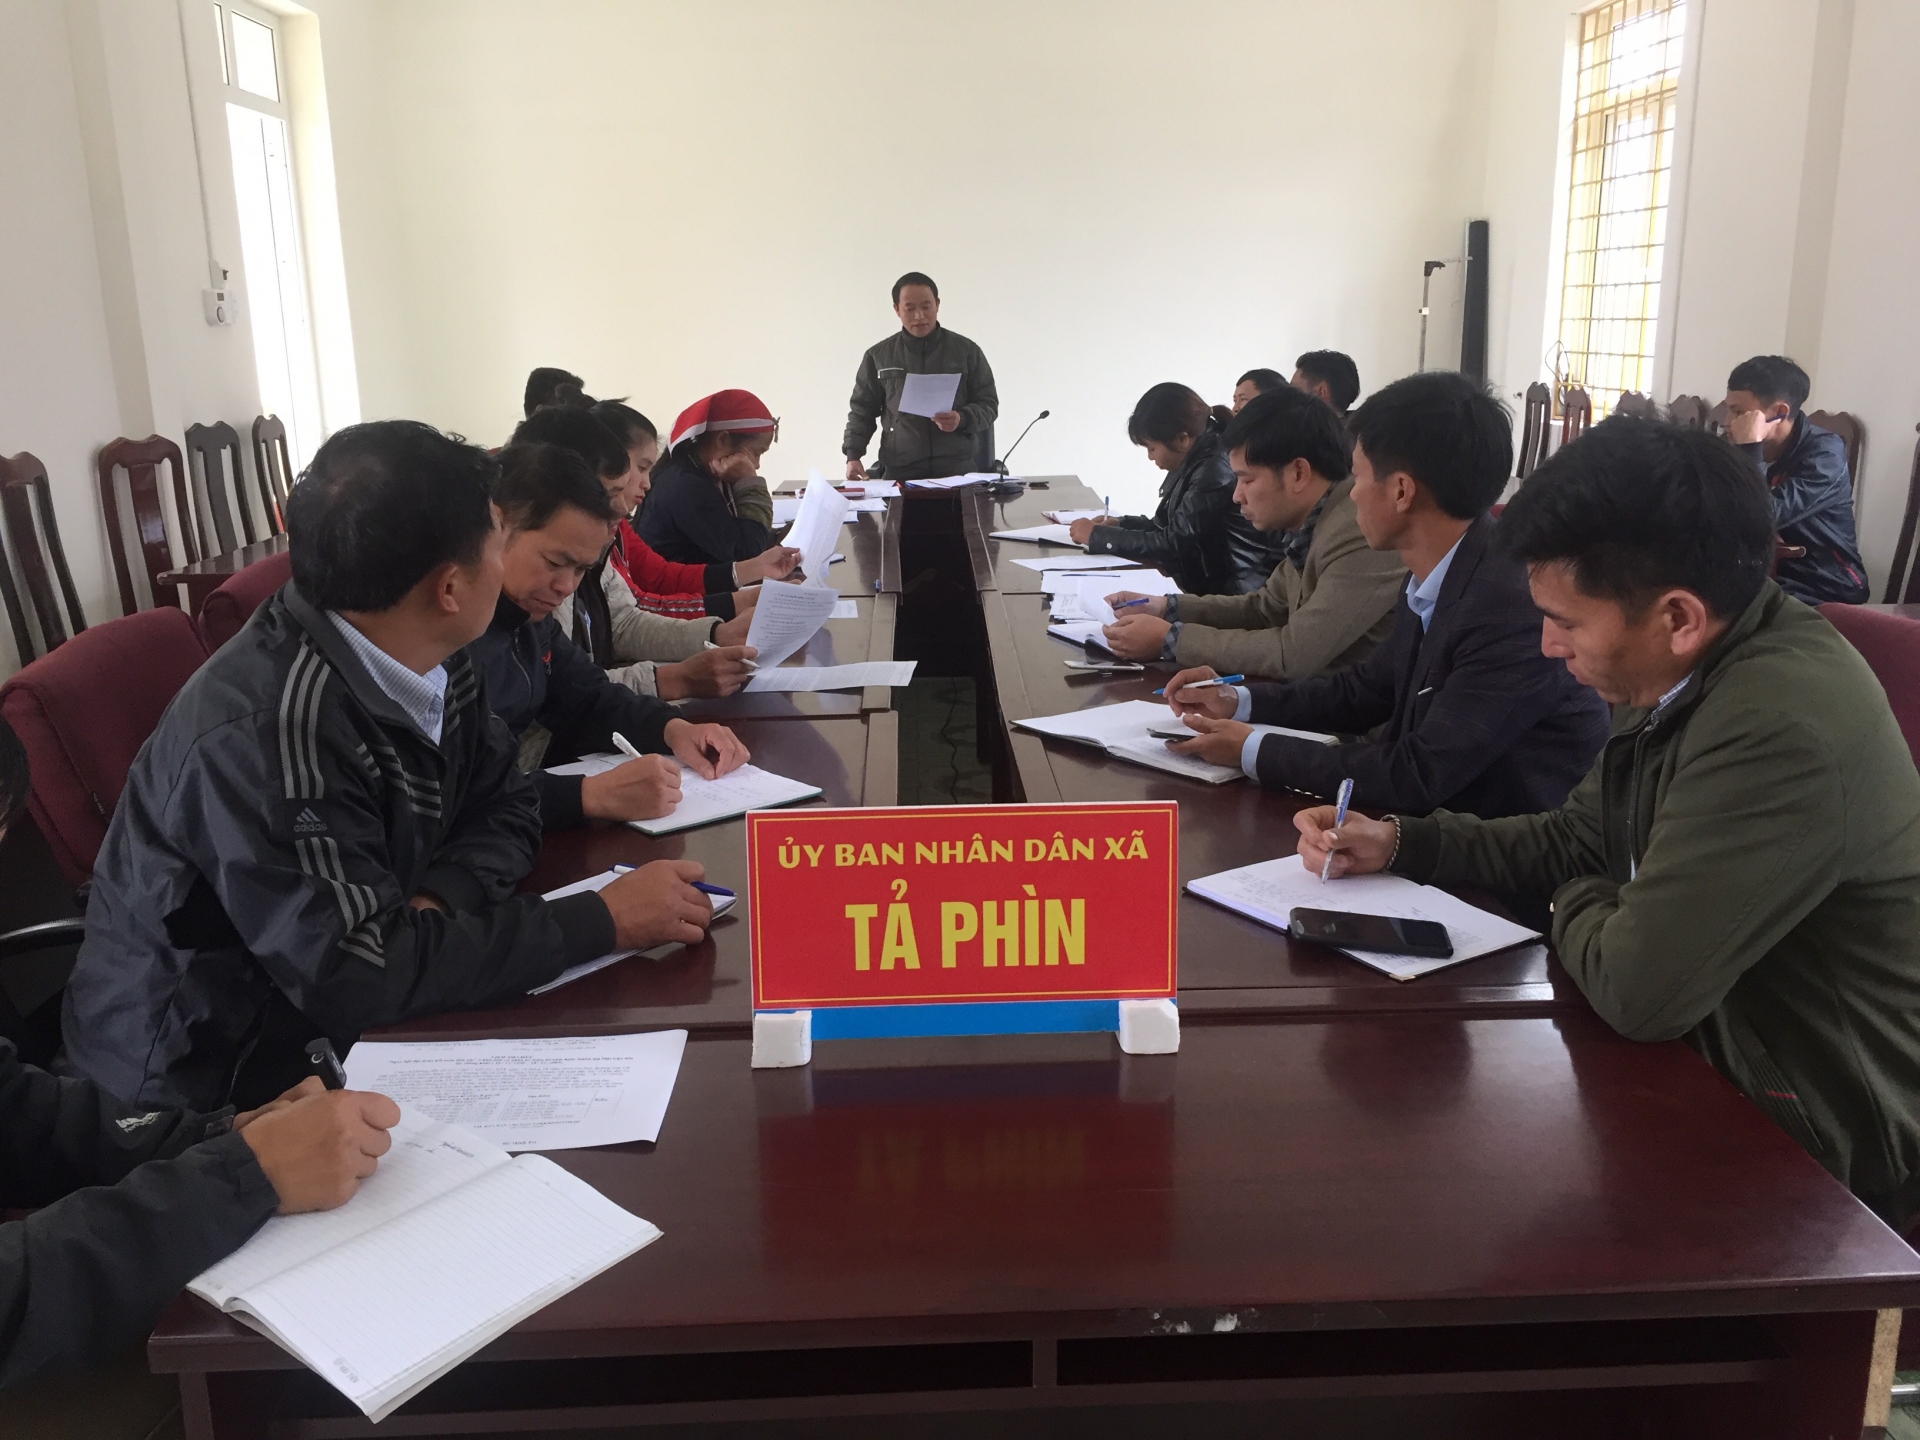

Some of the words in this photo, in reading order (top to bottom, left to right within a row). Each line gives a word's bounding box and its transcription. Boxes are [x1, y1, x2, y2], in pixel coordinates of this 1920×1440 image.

[294, 822, 328, 832] adidas
[778, 836, 825, 869] ỦY
[834, 842, 904, 867] BAN
[915, 833, 1014, 865] NHÂN
[1024, 831, 1095, 862] DÂN
[1103, 829, 1149, 860] XÃ
[845, 878, 921, 971] TẢ
[940, 884, 1086, 969] PHÌN
